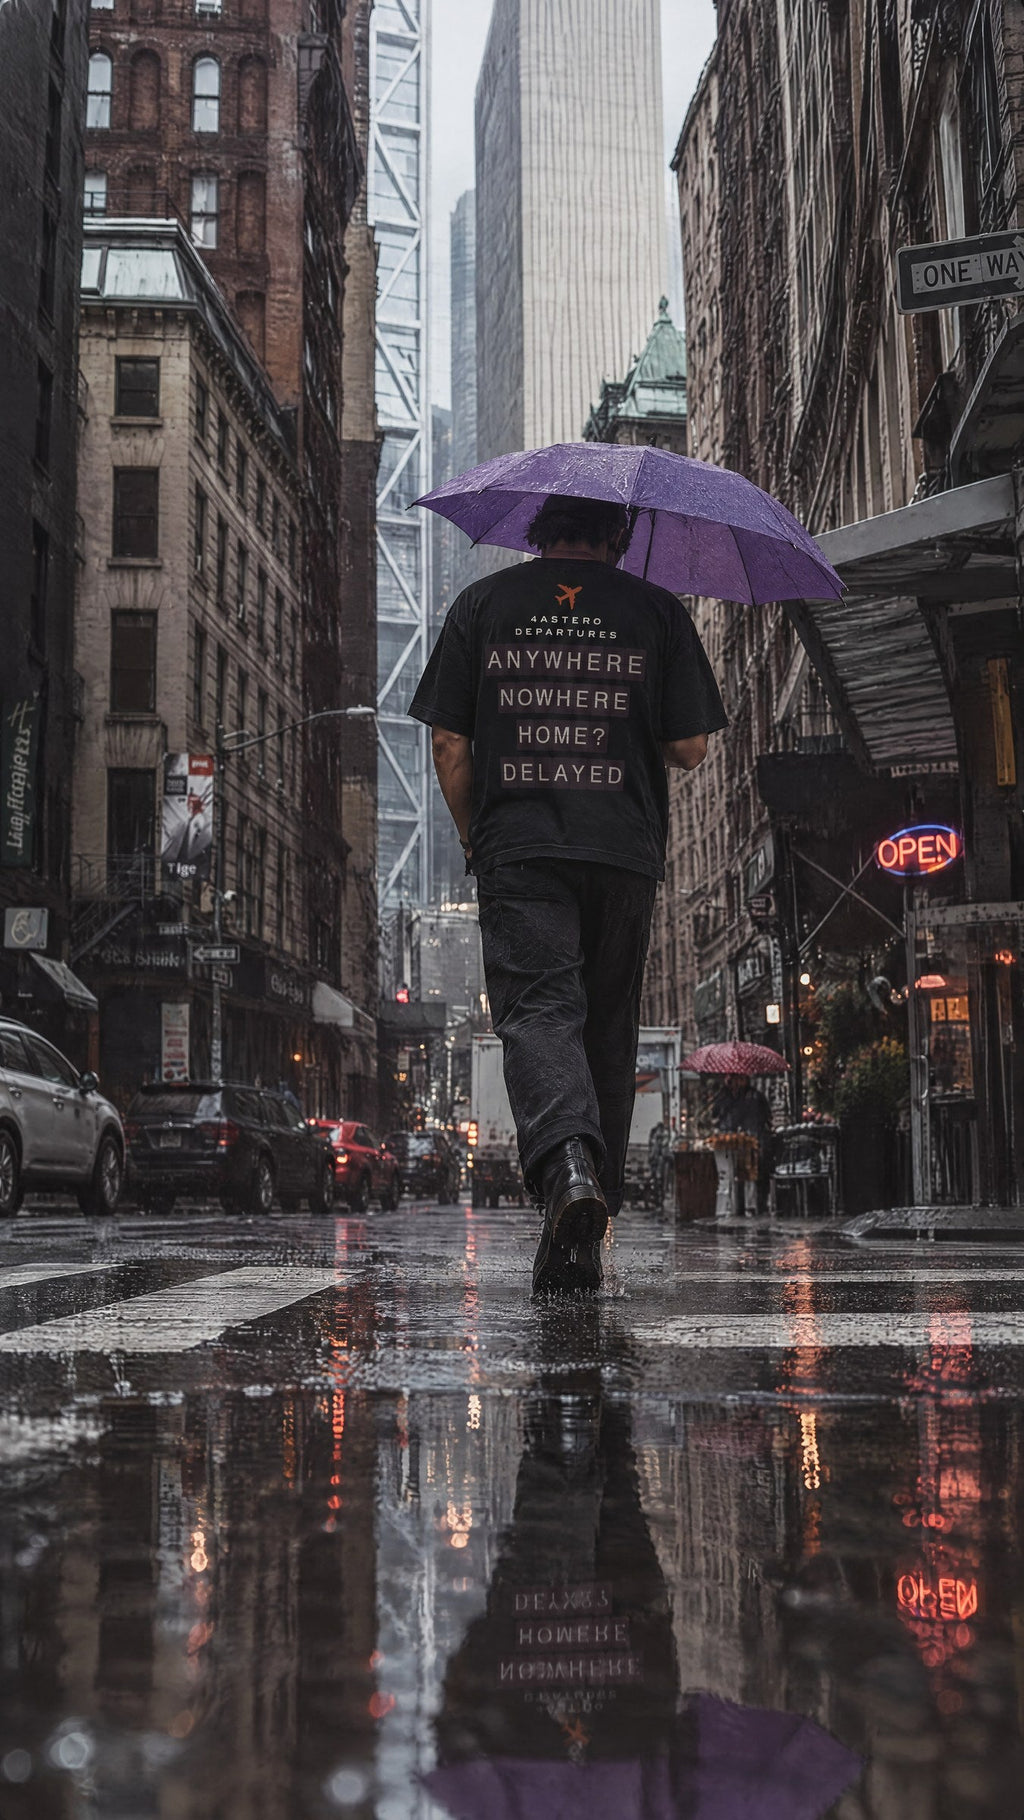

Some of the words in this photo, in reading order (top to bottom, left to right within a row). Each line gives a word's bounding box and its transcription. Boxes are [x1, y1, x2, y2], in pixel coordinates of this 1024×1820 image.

[923, 259, 973, 288] ONE
[530, 615, 602, 625] 4ASTERO
[515, 628, 617, 639] DEPARTURES
[487, 650, 644, 675] ANYWHERE
[500, 688, 628, 711] NOWHERE
[518, 725, 606, 746] HOME?
[503, 763, 623, 784] DELAYED
[877, 832, 957, 868] OPEN
